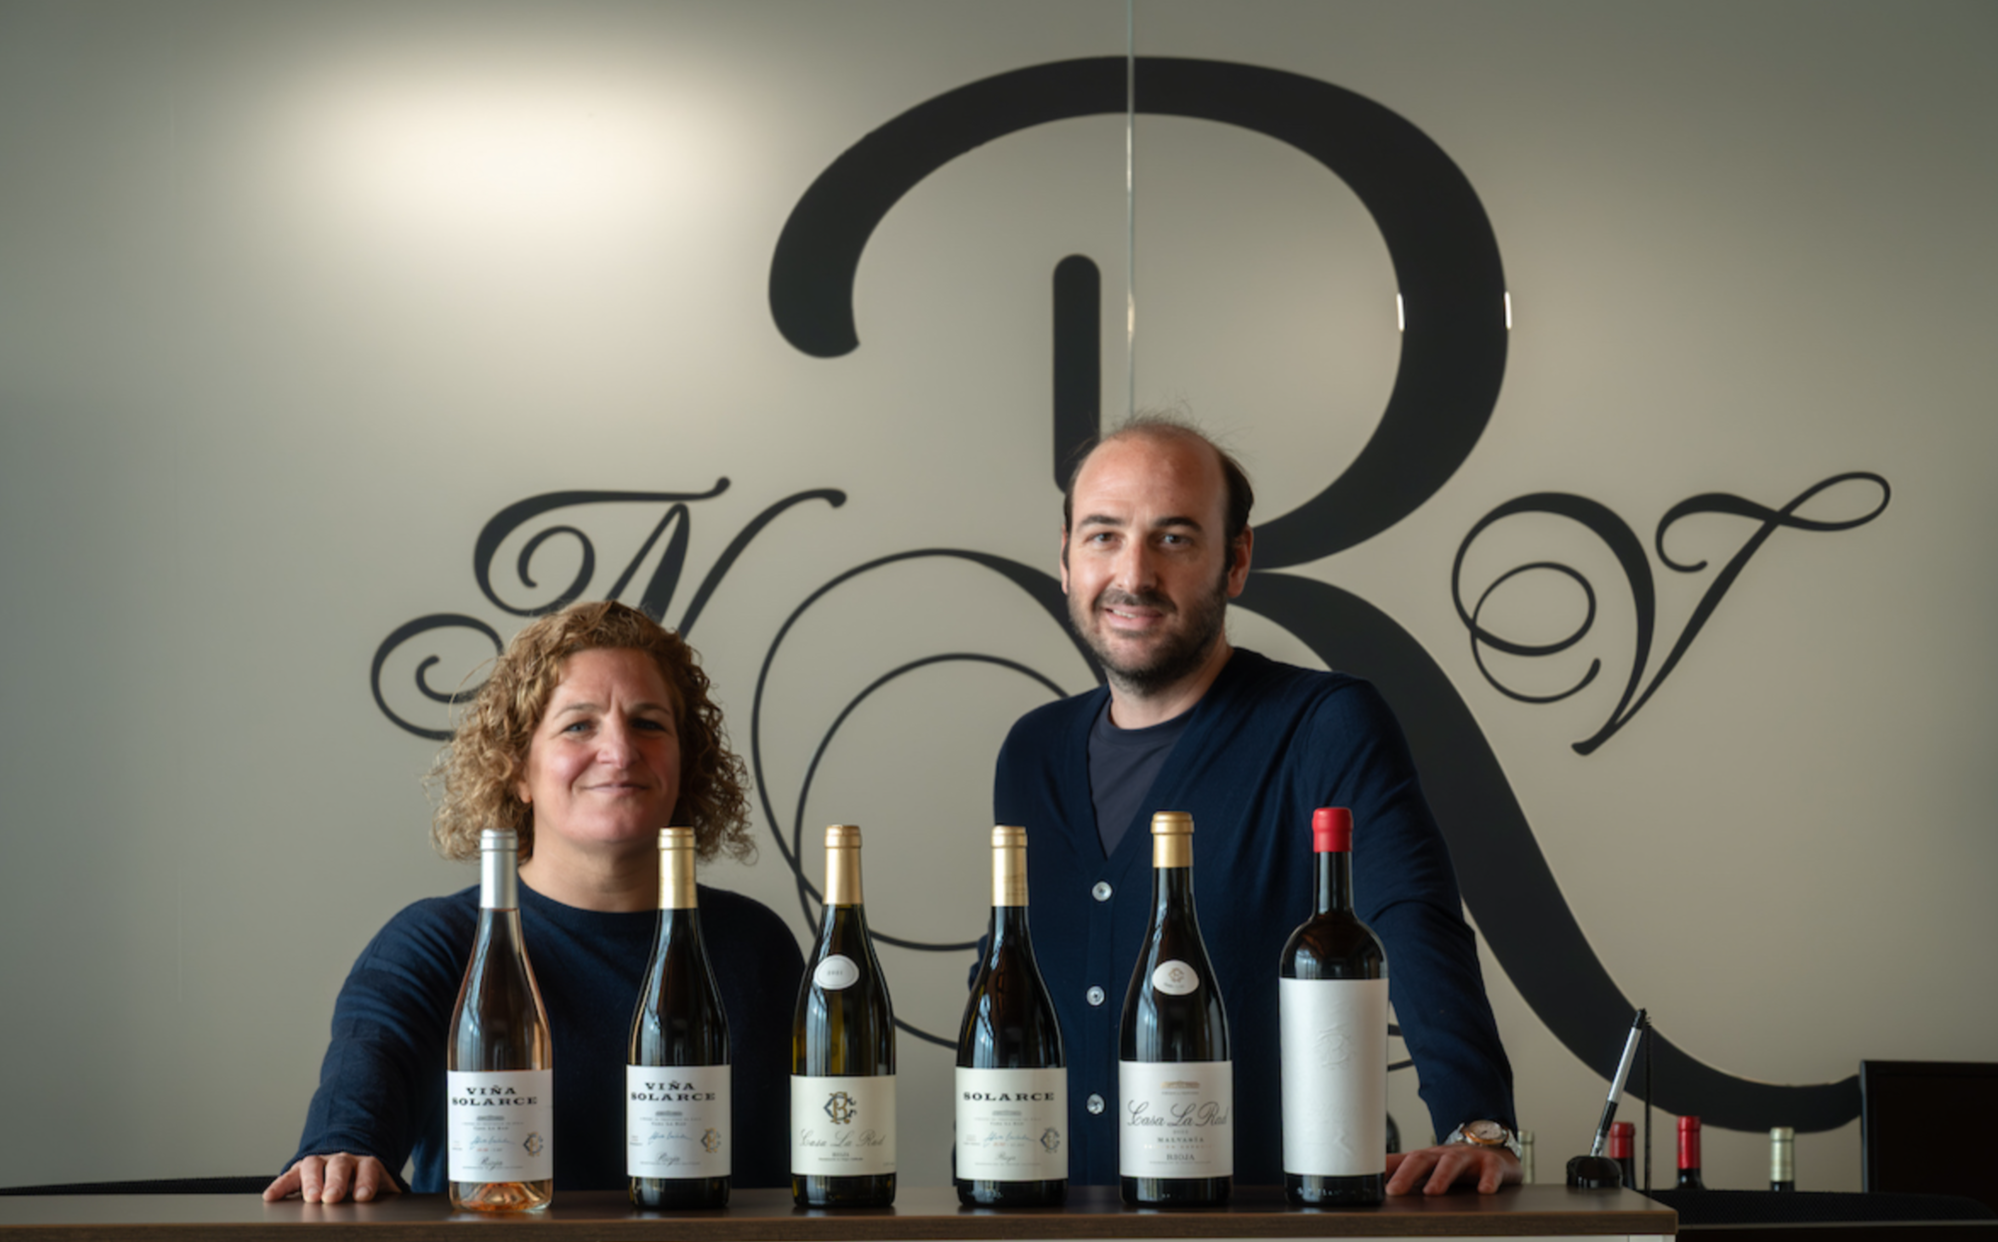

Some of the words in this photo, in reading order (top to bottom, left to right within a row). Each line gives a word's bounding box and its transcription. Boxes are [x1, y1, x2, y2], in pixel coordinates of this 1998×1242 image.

[645, 1080, 695, 1090] VIÑA
[466, 1085, 516, 1095] VIÑA
[631, 1092, 715, 1101] SOLARCE
[963, 1092, 1054, 1101] SOLARCE
[452, 1097, 537, 1106] SOLARCE
[1127, 1100, 1165, 1126] Casa
[1167, 1103, 1196, 1127] La
[1195, 1101, 1230, 1127] Rad
[799, 1129, 827, 1147] Casa
[830, 1130, 855, 1147] La
[856, 1129, 886, 1147] Rad
[1166, 1153, 1195, 1161] RIOJA
